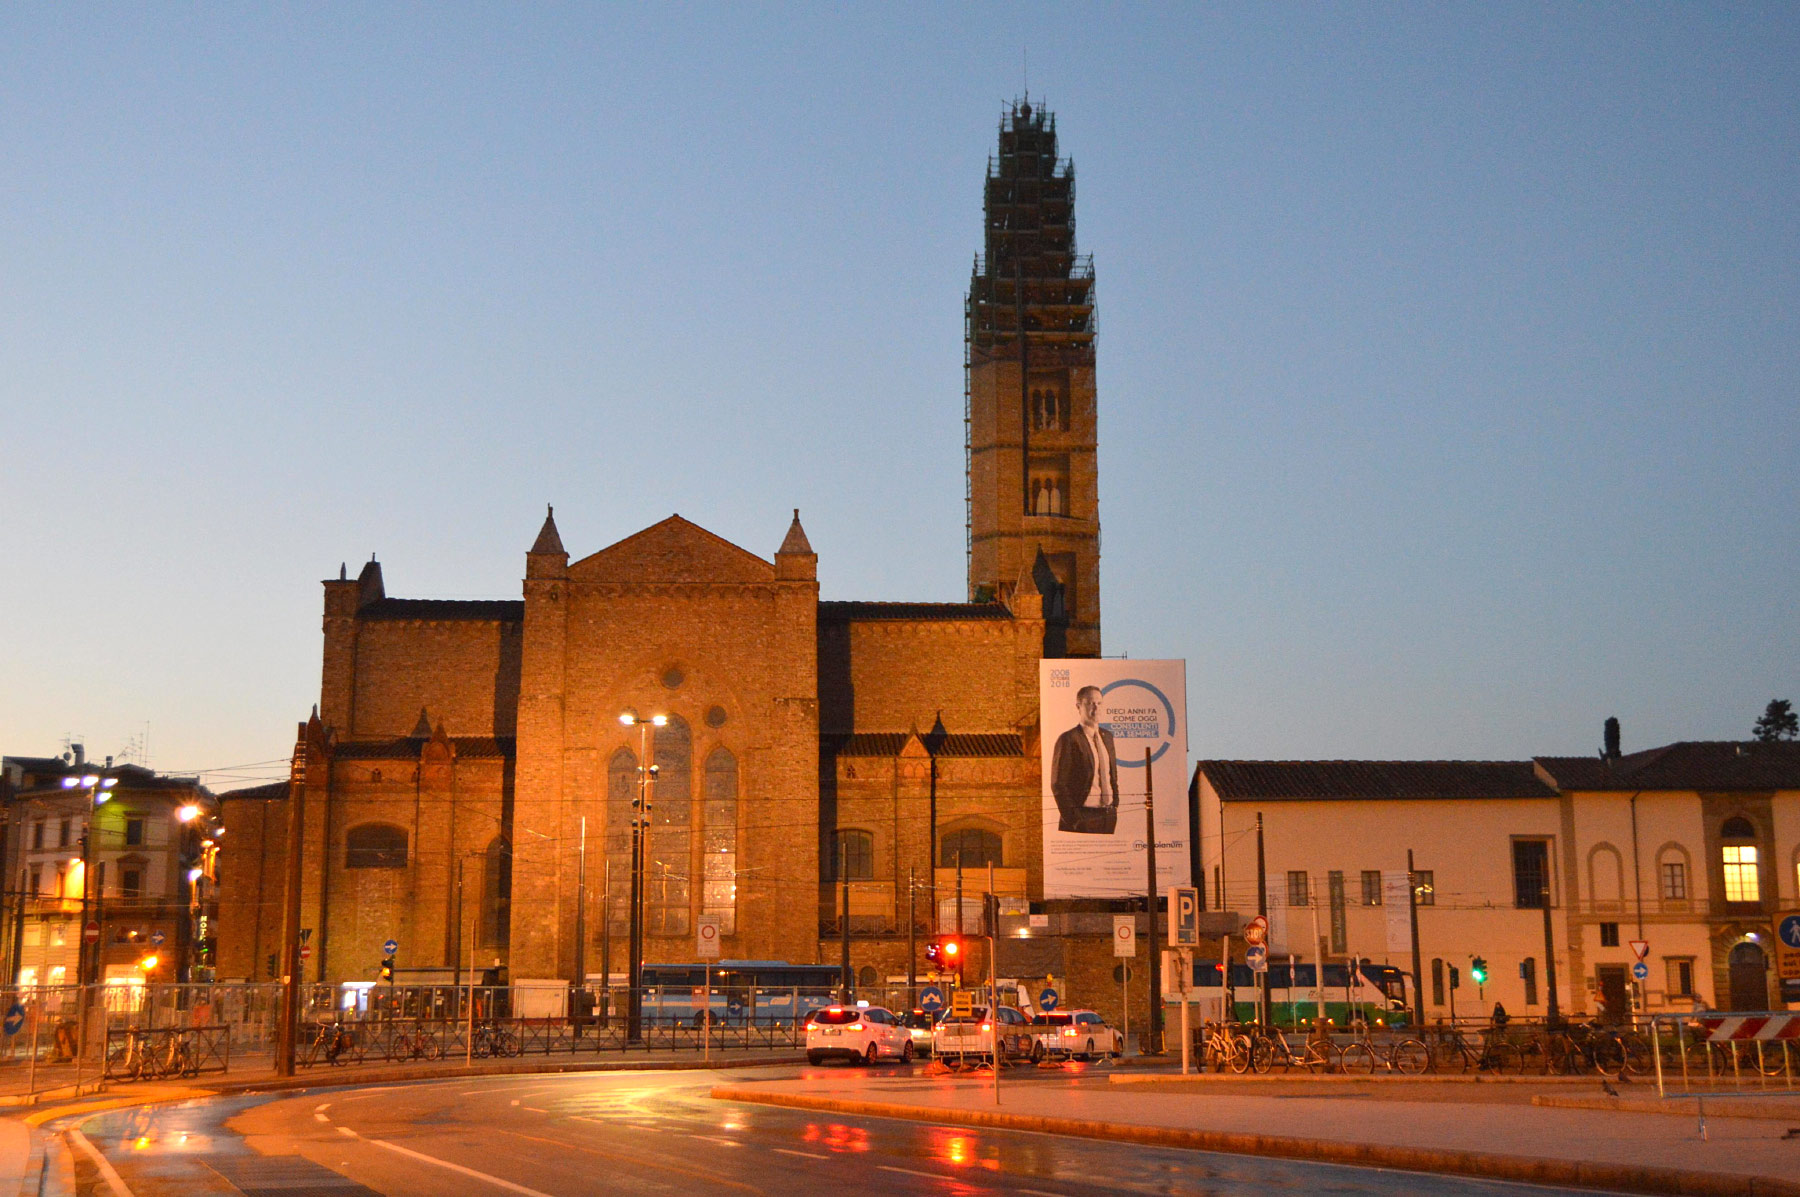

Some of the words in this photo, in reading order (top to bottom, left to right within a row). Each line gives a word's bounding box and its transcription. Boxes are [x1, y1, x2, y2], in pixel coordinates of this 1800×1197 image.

[1134, 841, 1183, 849] meolanum
[1180, 896, 1193, 925] P
[1246, 928, 1263, 938] STOP
